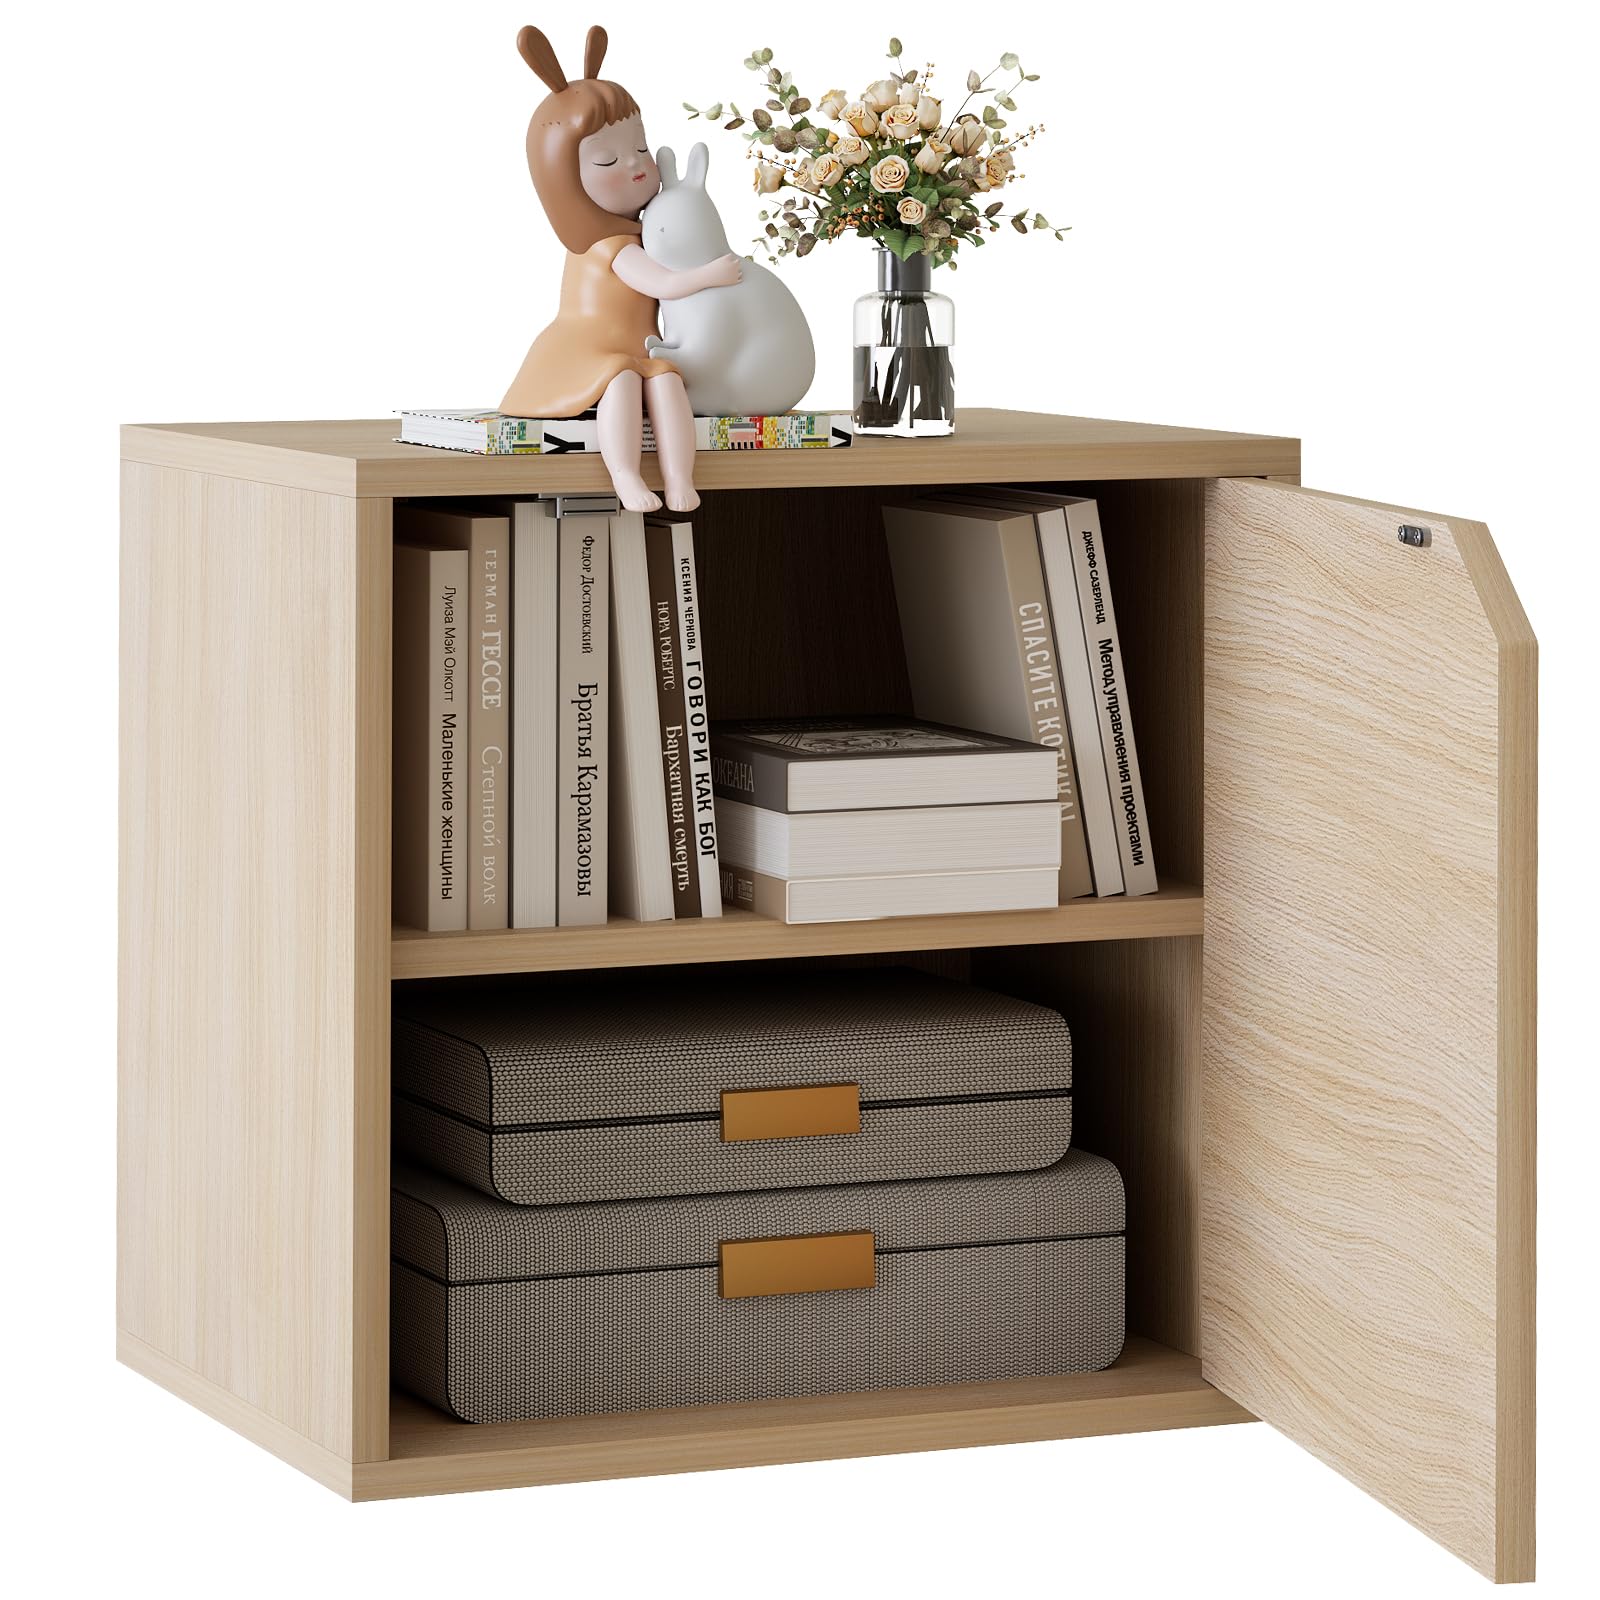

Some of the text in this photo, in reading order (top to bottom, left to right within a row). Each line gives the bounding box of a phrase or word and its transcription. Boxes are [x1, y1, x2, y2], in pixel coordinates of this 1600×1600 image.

[441, 585, 457, 703] Луиза Мэй Олкотт
[481, 549, 502, 709] ГЕРМАН ГЕССЕ
[657, 601, 675, 691] НОРА РОБЕРТС
[680, 558, 696, 651] КСЕНИЯ ЧЕРНОВА
[1018, 602, 1058, 712] СПАСИТЕ
[1082, 531, 1106, 625] ДЖЕФФ САЗЕРЛЕНД
[438, 714, 457, 900] Маленькие женщины
[481, 746, 503, 905] Степной волк
[570, 683, 598, 897] Братья Карамазовы
[663, 725, 690, 892] Бархатная смерть
[686, 661, 716, 859] ГОВОРИ КАК БОГ
[713, 757, 755, 793] ОКЕАНА
[1098, 638, 1144, 866] Метод управляения проектами
